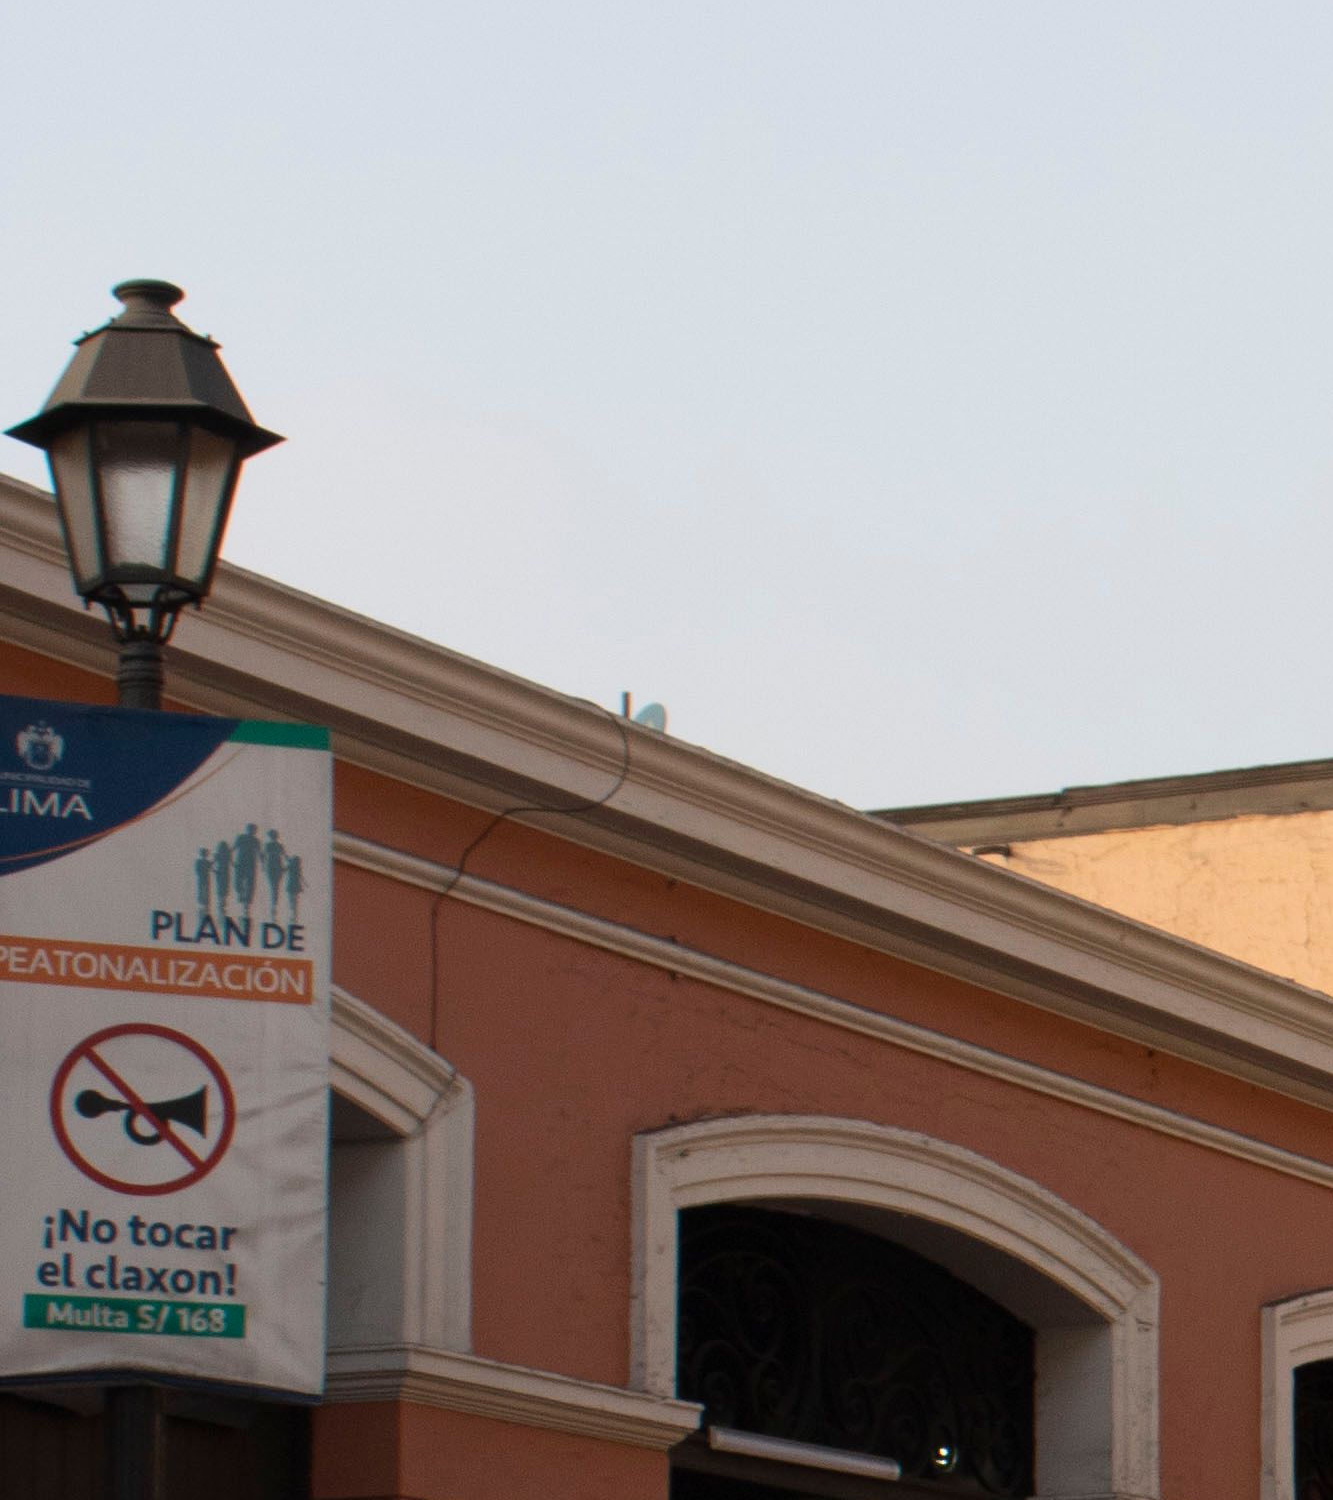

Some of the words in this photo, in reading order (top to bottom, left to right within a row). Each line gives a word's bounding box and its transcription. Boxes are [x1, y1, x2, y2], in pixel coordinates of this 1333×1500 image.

[0, 788, 93, 820] IMA
[151, 910, 250, 947] PLAN
[262, 924, 305, 951] DE
[43, 1208, 119, 1249] ¡No
[128, 1214, 238, 1251] tocar
[37, 1253, 74, 1287] el
[86, 1255, 238, 1296] claxon!
[47, 1301, 129, 1328] Multa
[136, 1304, 169, 1332] S/
[176, 1307, 226, 1333] 168
